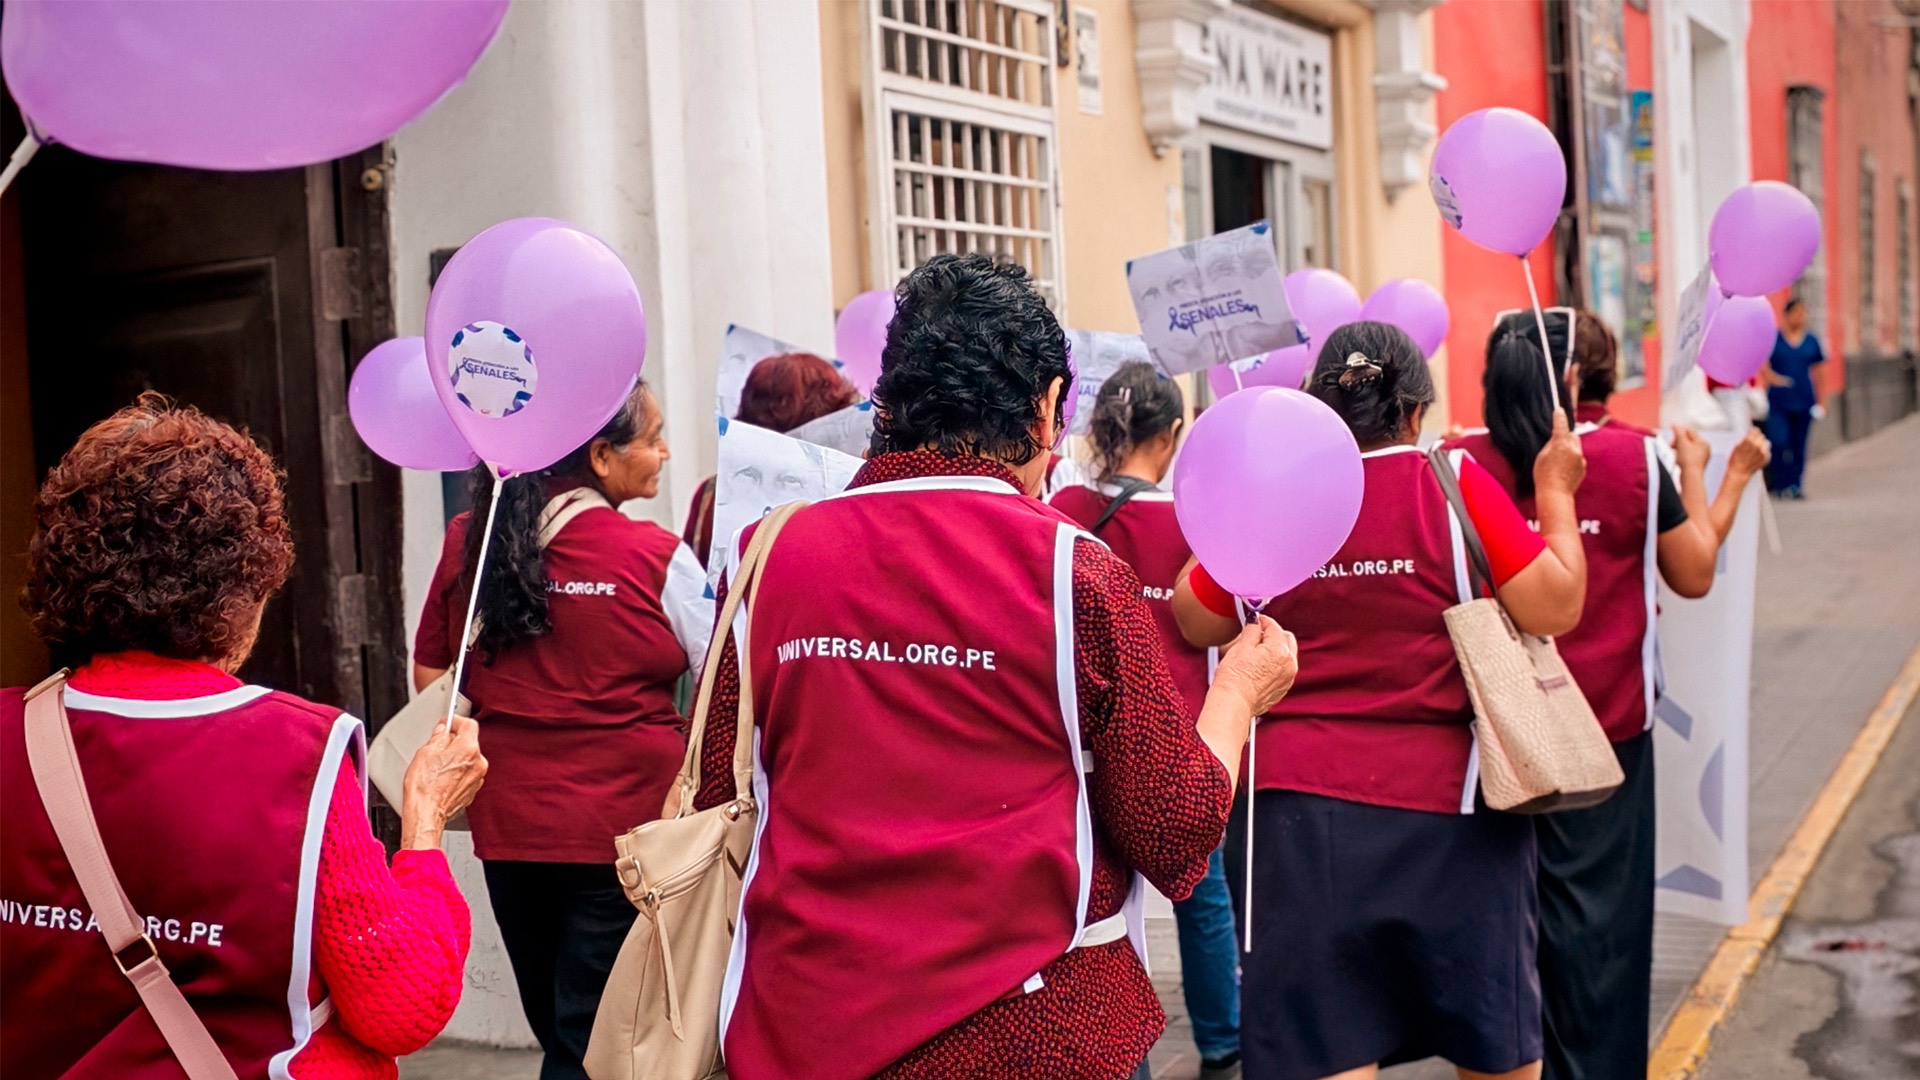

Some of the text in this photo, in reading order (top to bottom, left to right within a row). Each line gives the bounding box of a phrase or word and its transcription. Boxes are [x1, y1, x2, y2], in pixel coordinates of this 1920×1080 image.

[1257, 43, 1323, 116] WARE
[1312, 559, 1415, 579] SAL.ORG.PE
[546, 581, 617, 596] AL.ORG.PE
[1143, 585, 1175, 601] RG.P
[777, 636, 996, 671] UNIVERSAL.ORG.PE
